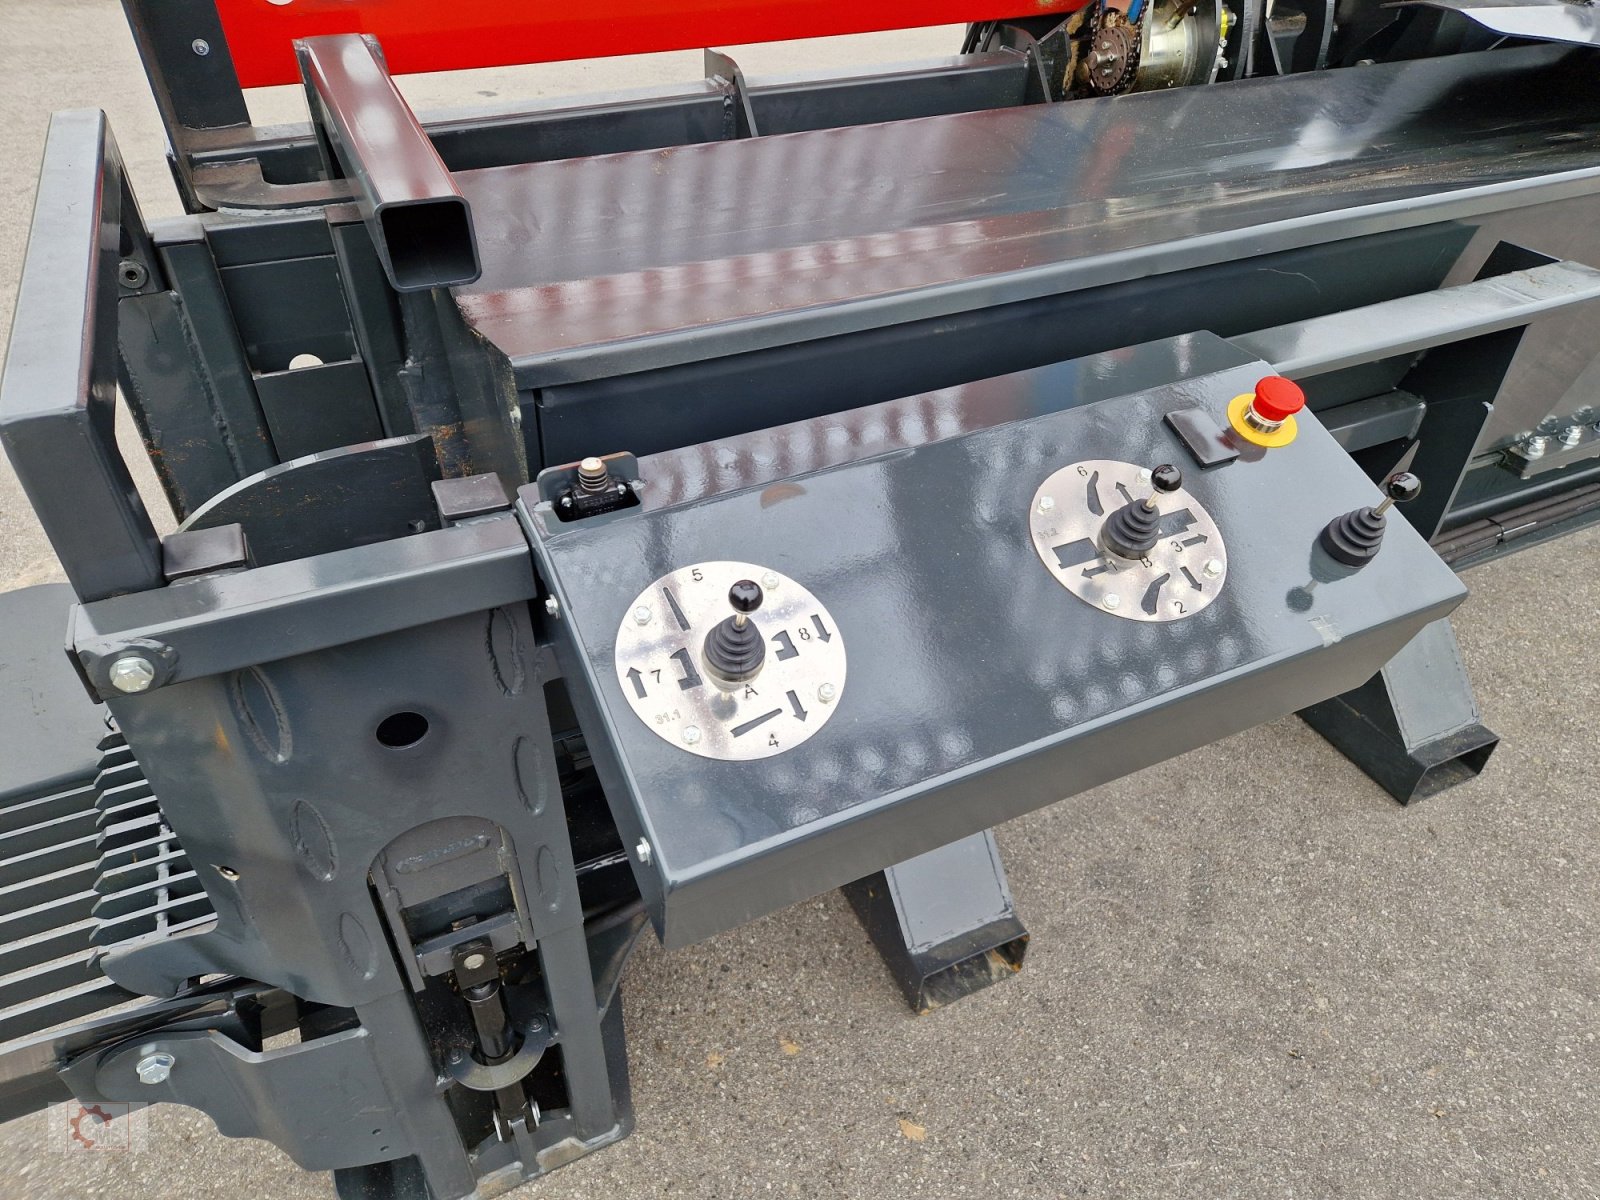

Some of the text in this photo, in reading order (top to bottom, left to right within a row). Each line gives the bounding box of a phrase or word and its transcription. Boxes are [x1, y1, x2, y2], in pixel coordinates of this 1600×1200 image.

[1076, 465, 1088, 477] 6
[1170, 540, 1183, 553] 3
[691, 568, 704, 582] 5
[1174, 601, 1188, 614] 2
[798, 627, 811, 641] 8
[650, 668, 662, 684] 7
[744, 683, 759, 699] A
[767, 733, 780, 748] 4
